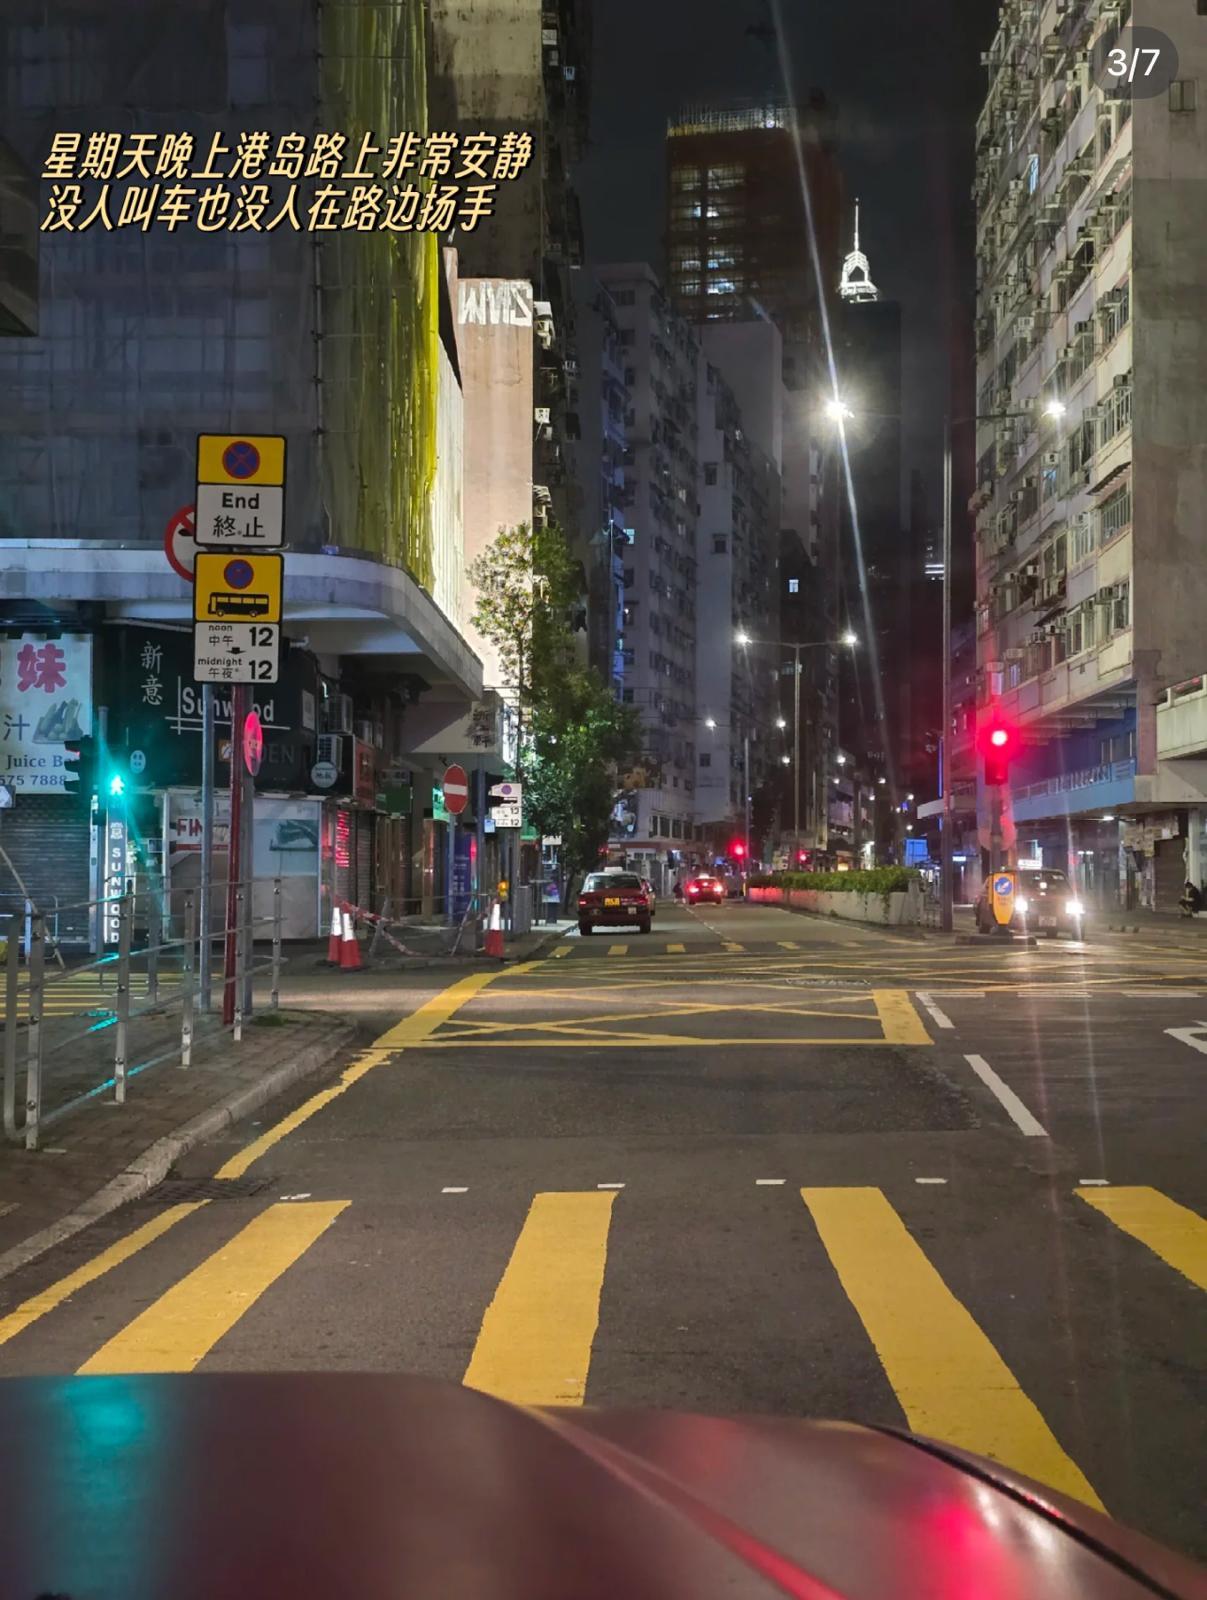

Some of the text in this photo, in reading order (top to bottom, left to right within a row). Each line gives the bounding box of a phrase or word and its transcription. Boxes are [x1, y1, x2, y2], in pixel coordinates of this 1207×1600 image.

[222, 492, 259, 509] End
[213, 515, 265, 538] 終止
[208, 623, 272, 647] noon 12
[208, 635, 234, 647] 中午
[17, 643, 67, 693] 妹
[140, 641, 164, 705] 新意
[197, 656, 272, 680] midnight 12
[207, 667, 233, 679] 午夜
[7, 754, 46, 770] Juice
